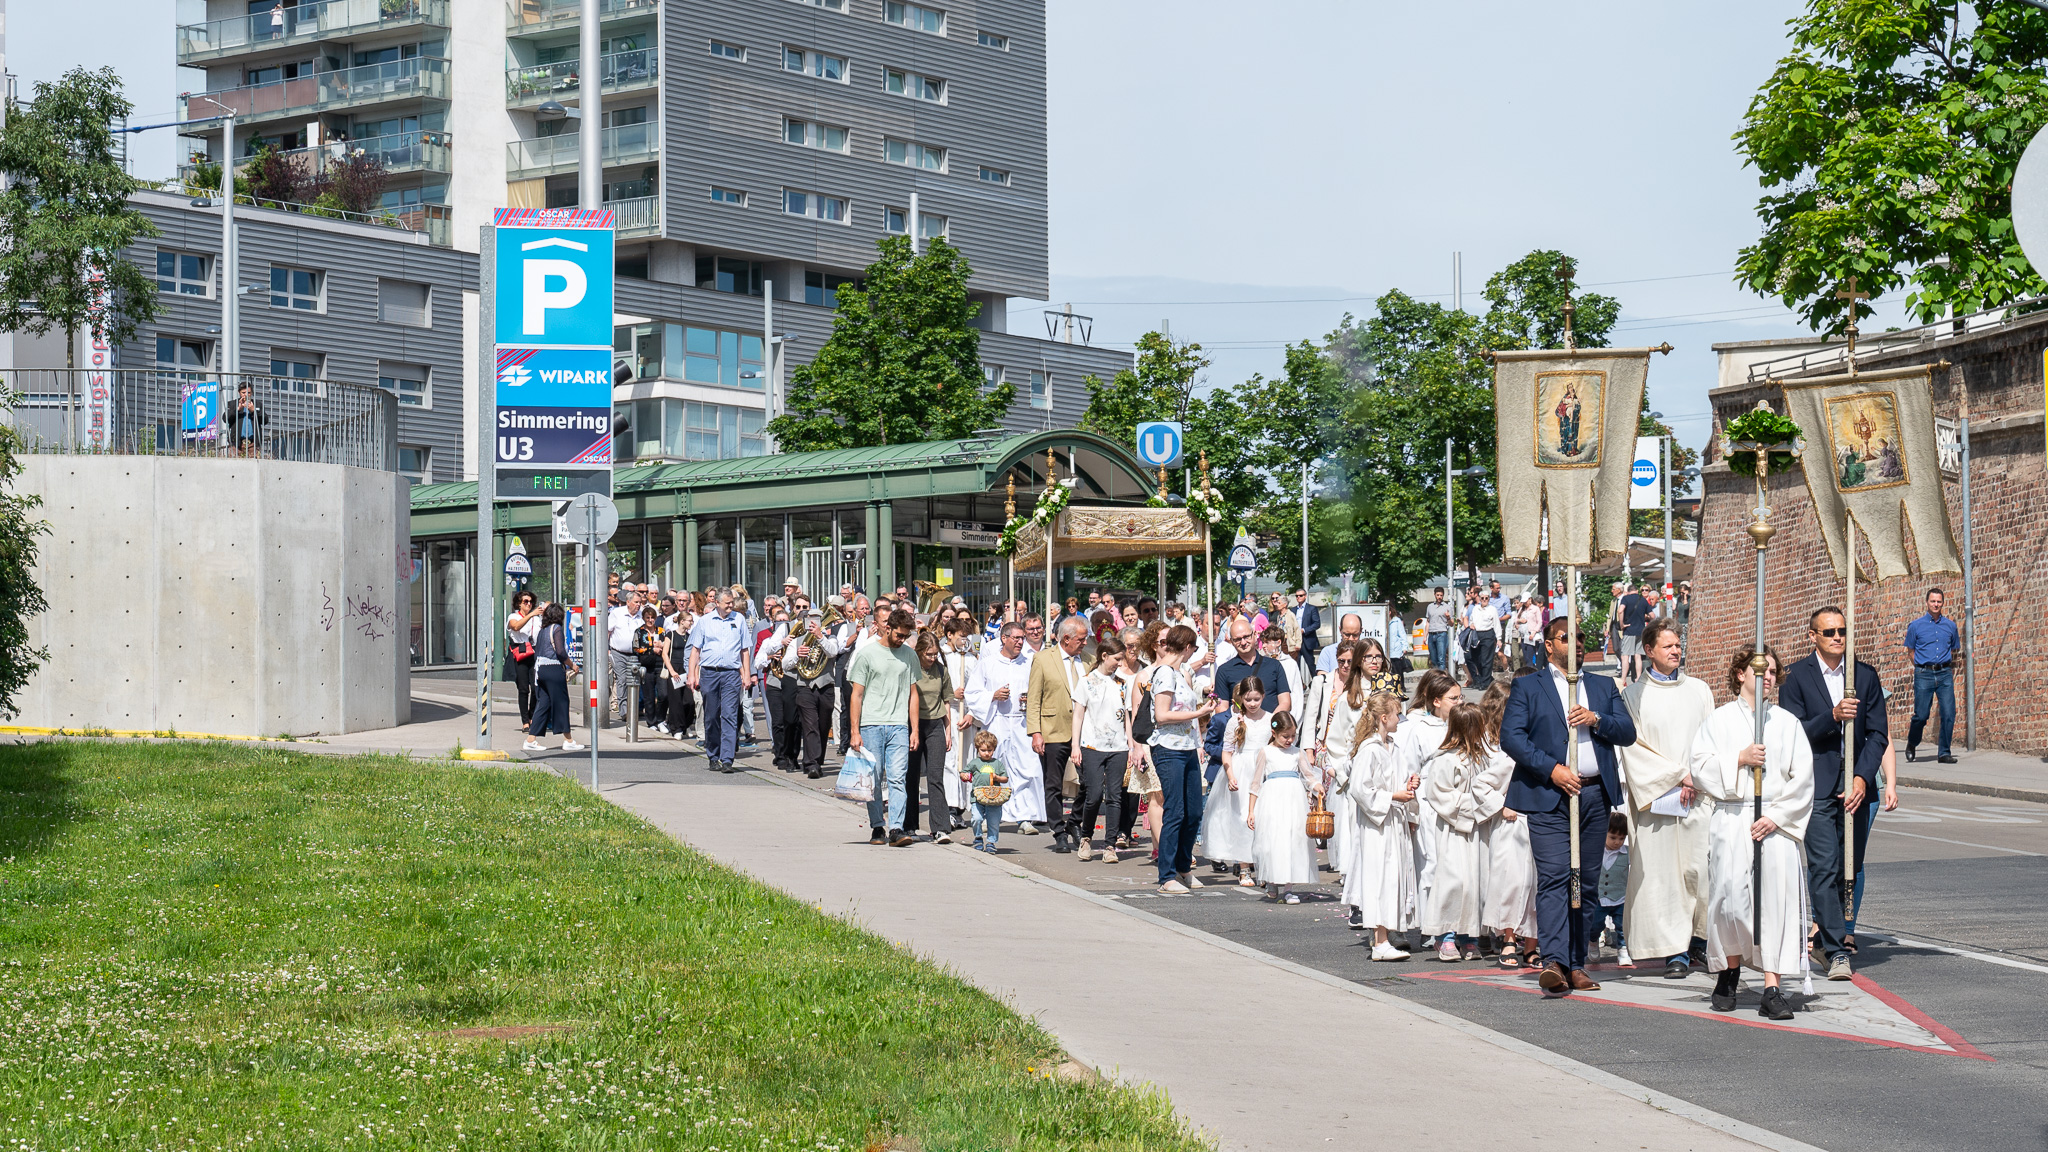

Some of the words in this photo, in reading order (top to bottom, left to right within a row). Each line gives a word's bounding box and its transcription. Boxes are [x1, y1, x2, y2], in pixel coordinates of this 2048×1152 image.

[538, 210, 570, 218] OSCAR
[523, 259, 587, 335] P
[539, 369, 609, 384] WIPARK
[498, 409, 608, 434] Simmering
[499, 436, 534, 460] U3
[1145, 433, 1172, 463] U
[583, 455, 608, 463] OSCAR
[533, 475, 568, 490] FREI
[961, 531, 998, 544] Simmering
